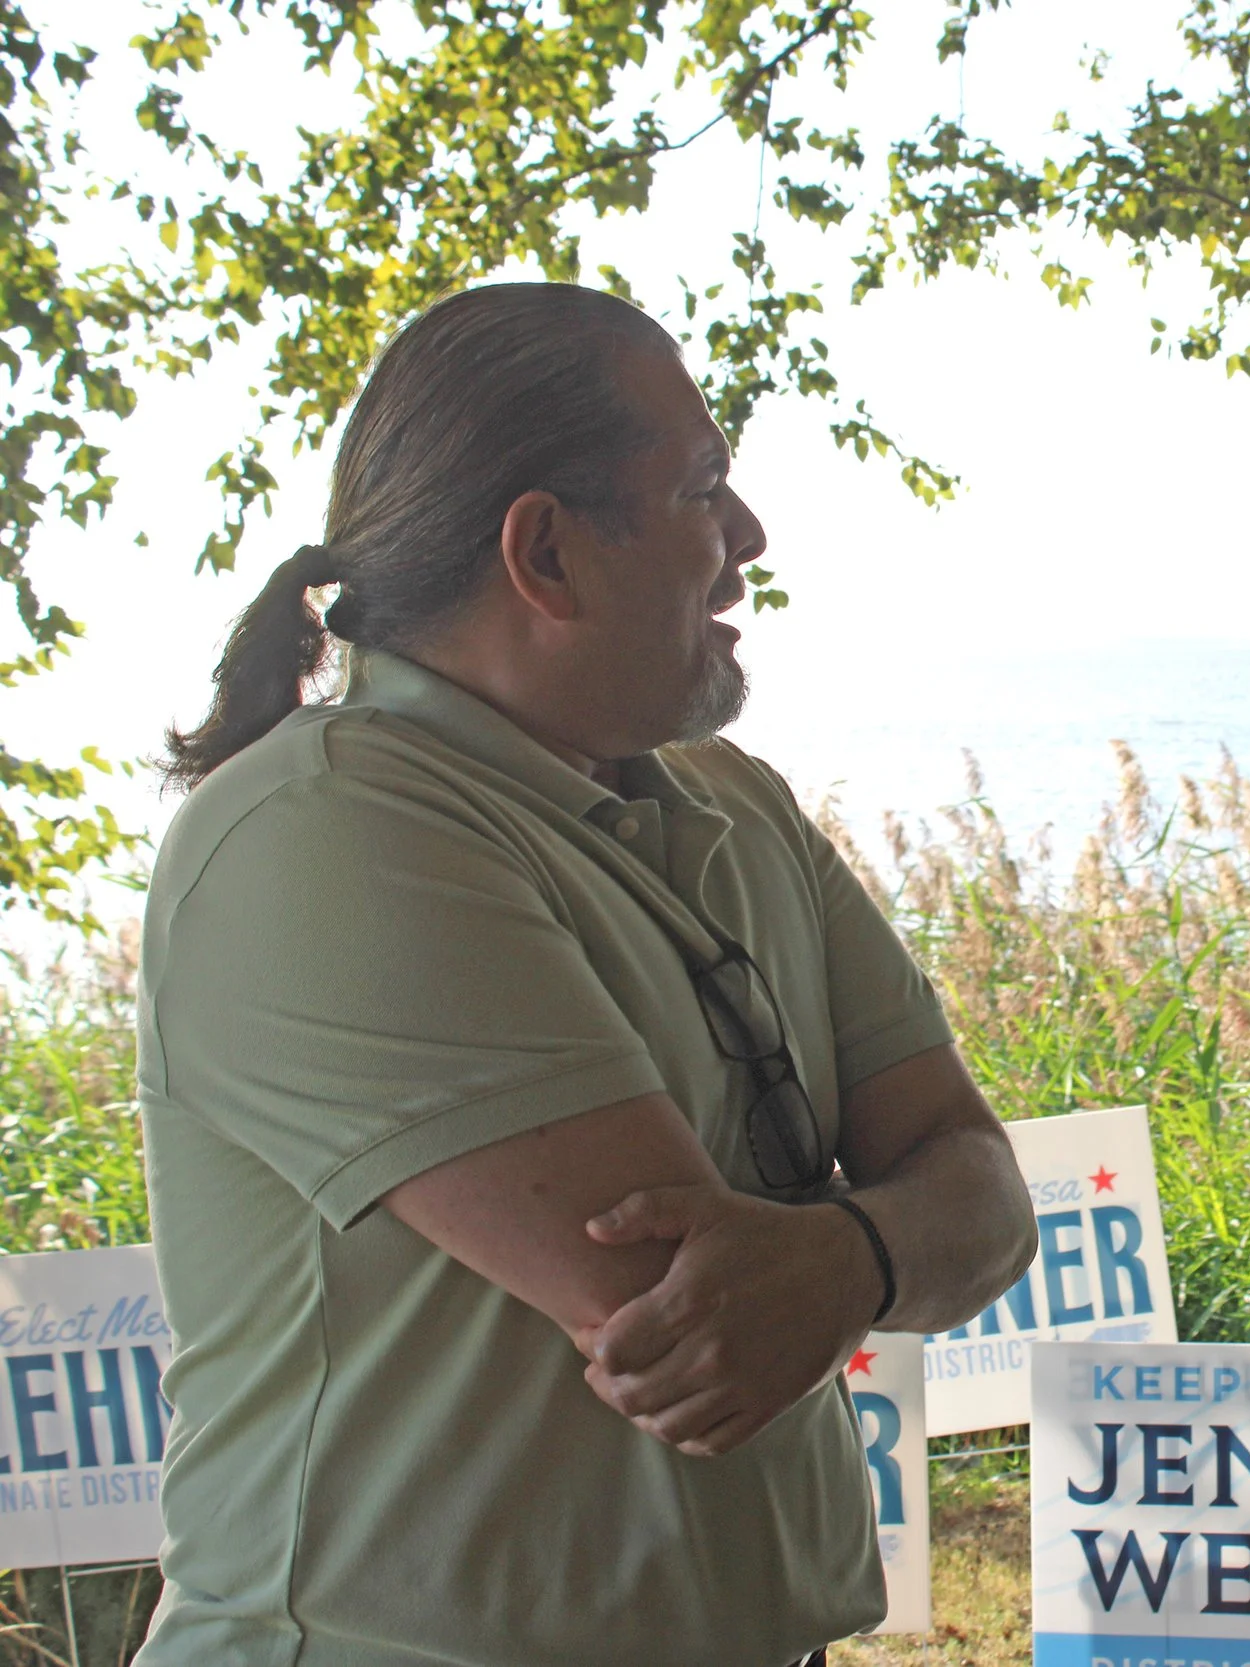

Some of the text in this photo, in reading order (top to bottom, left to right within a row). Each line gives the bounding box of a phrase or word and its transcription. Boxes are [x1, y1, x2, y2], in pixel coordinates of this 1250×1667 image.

[0, 1295, 170, 1347] Elect Me
[923, 1337, 1038, 1381] DISTRIC
[1093, 1365, 1242, 1402] KEEP
